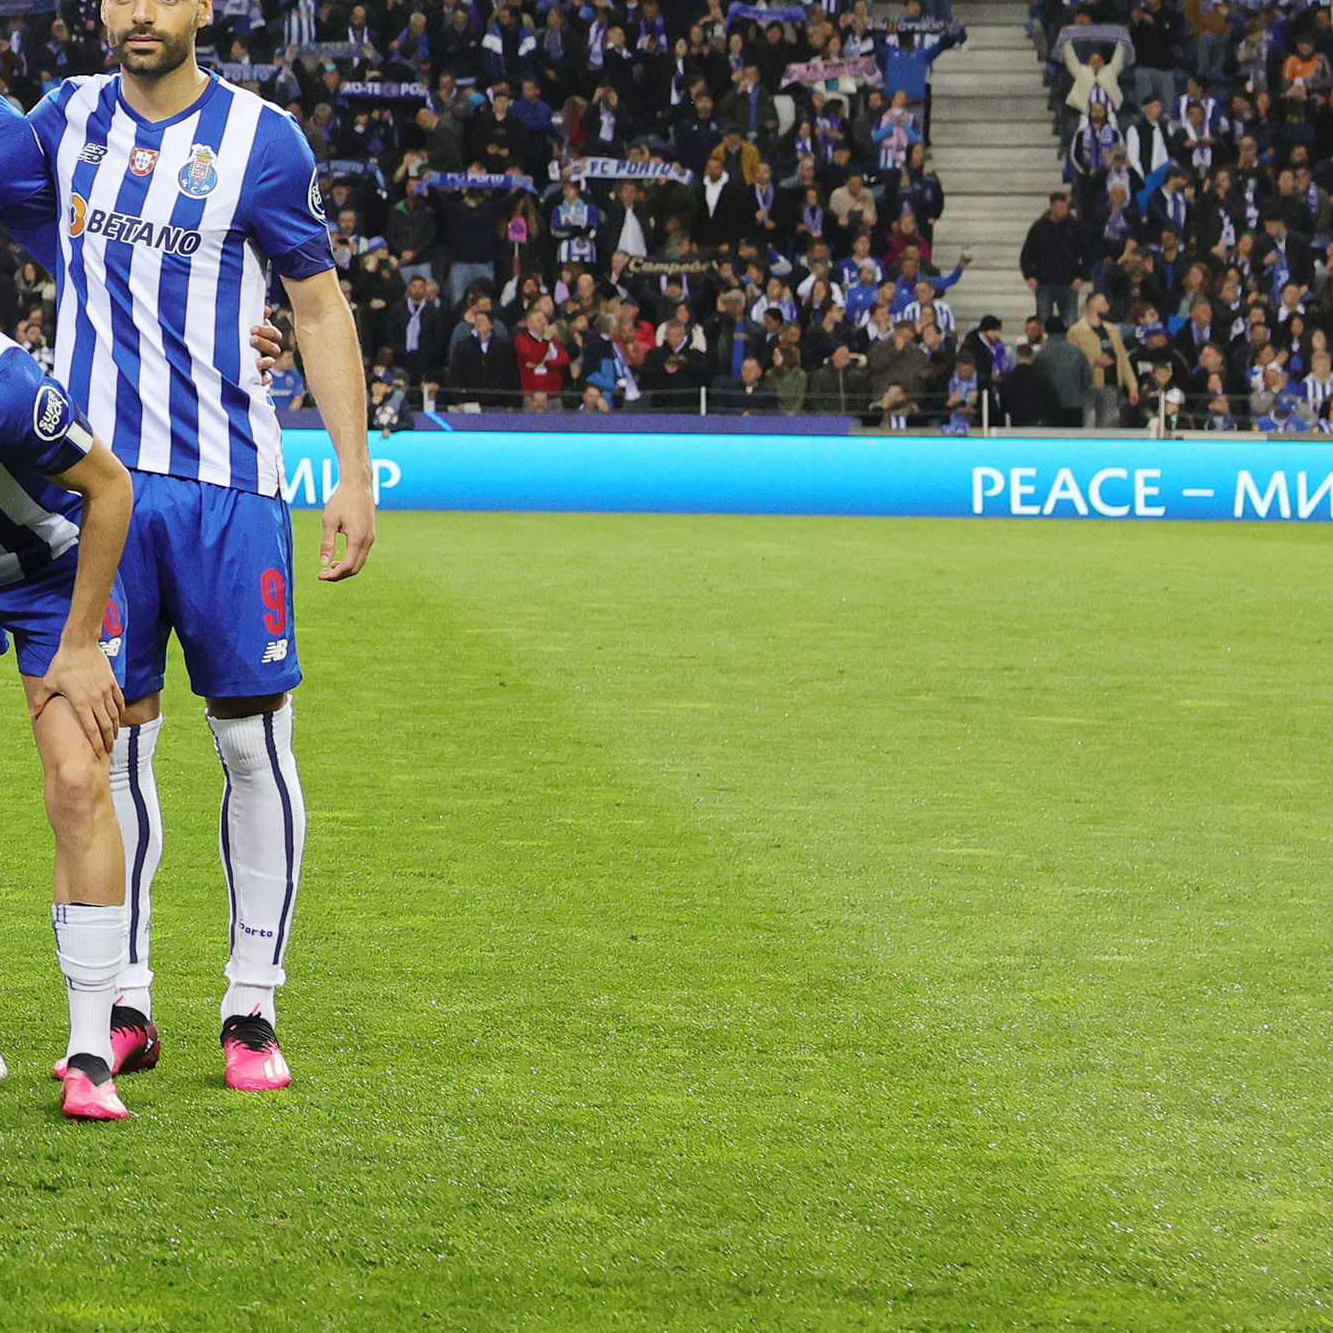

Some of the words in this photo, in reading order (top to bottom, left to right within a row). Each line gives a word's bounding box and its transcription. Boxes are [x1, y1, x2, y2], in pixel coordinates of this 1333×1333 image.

[590, 160, 608, 173] FC
[85, 208, 201, 255] BETANO
[39, 390, 61, 429] SUPER
[46, 400, 64, 433] BOCK
[971, 465, 1167, 518] PEACE
[259, 568, 286, 636] 9
